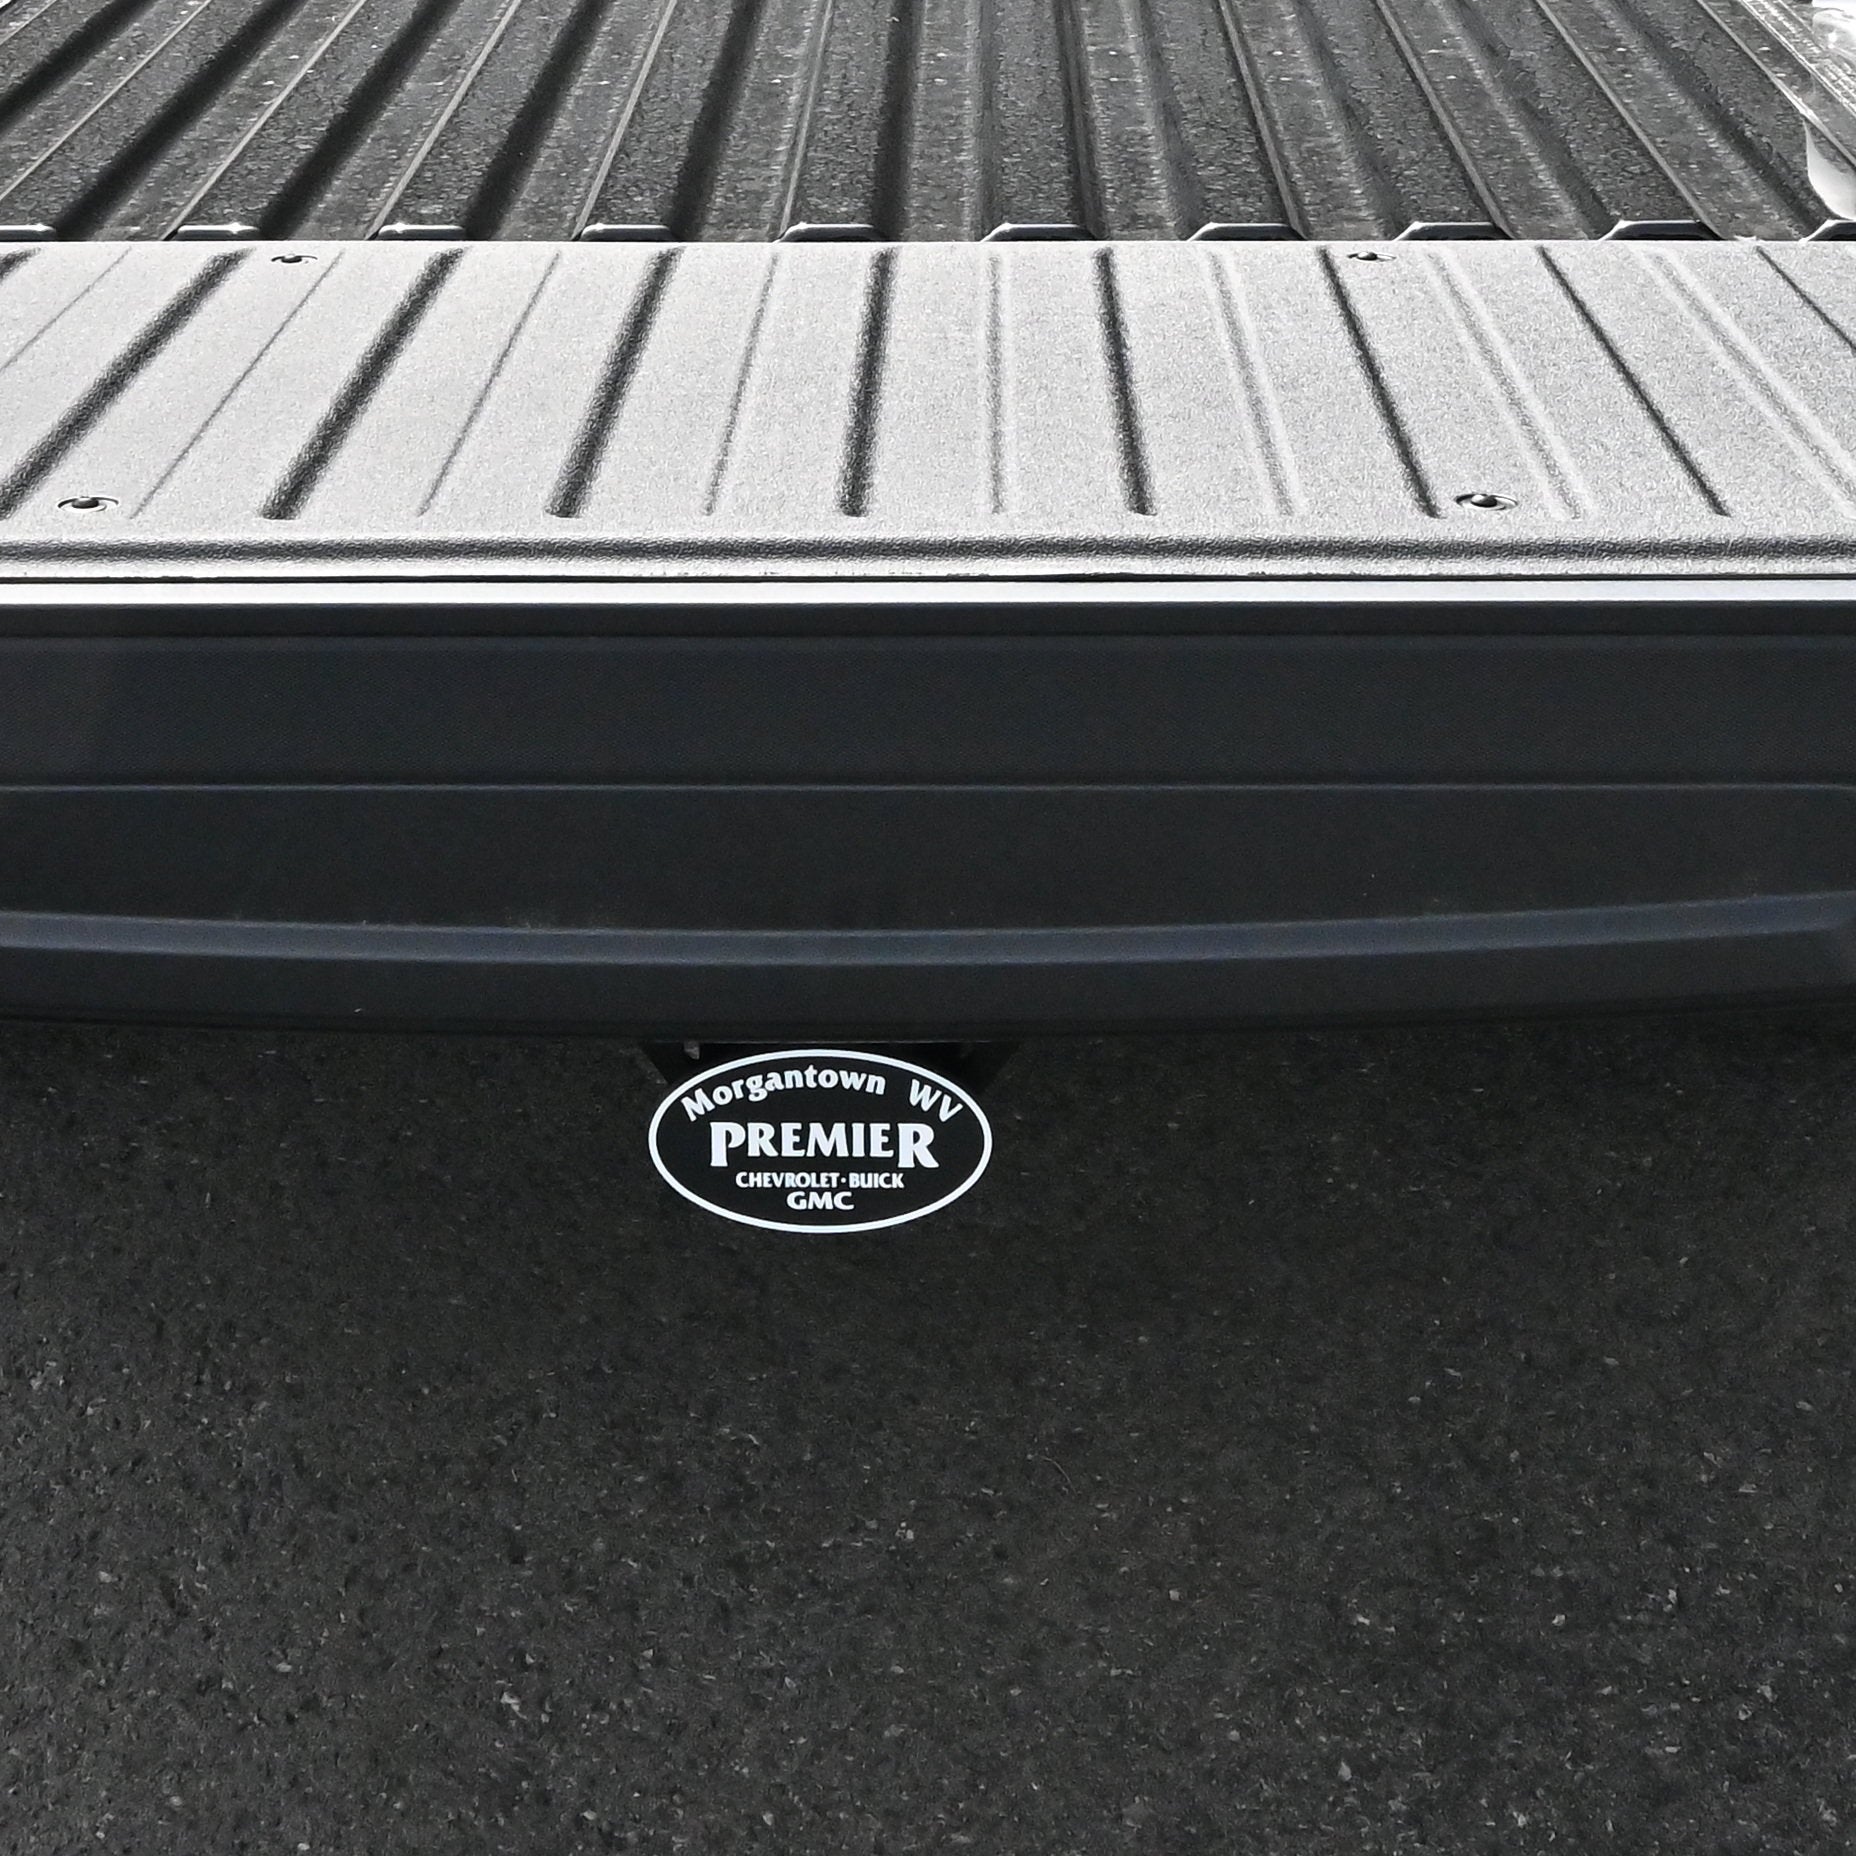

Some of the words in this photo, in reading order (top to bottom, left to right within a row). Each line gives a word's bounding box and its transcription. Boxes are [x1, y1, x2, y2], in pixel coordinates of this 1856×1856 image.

[681, 1063, 886, 1121] Morgantown
[908, 1078, 963, 1123] WV
[709, 1121, 940, 1169] PREMIER
[735, 1171, 839, 1189] CHEVROLET
[848, 1171, 905, 1189] BUICK
[786, 1190, 855, 1211] GMC
